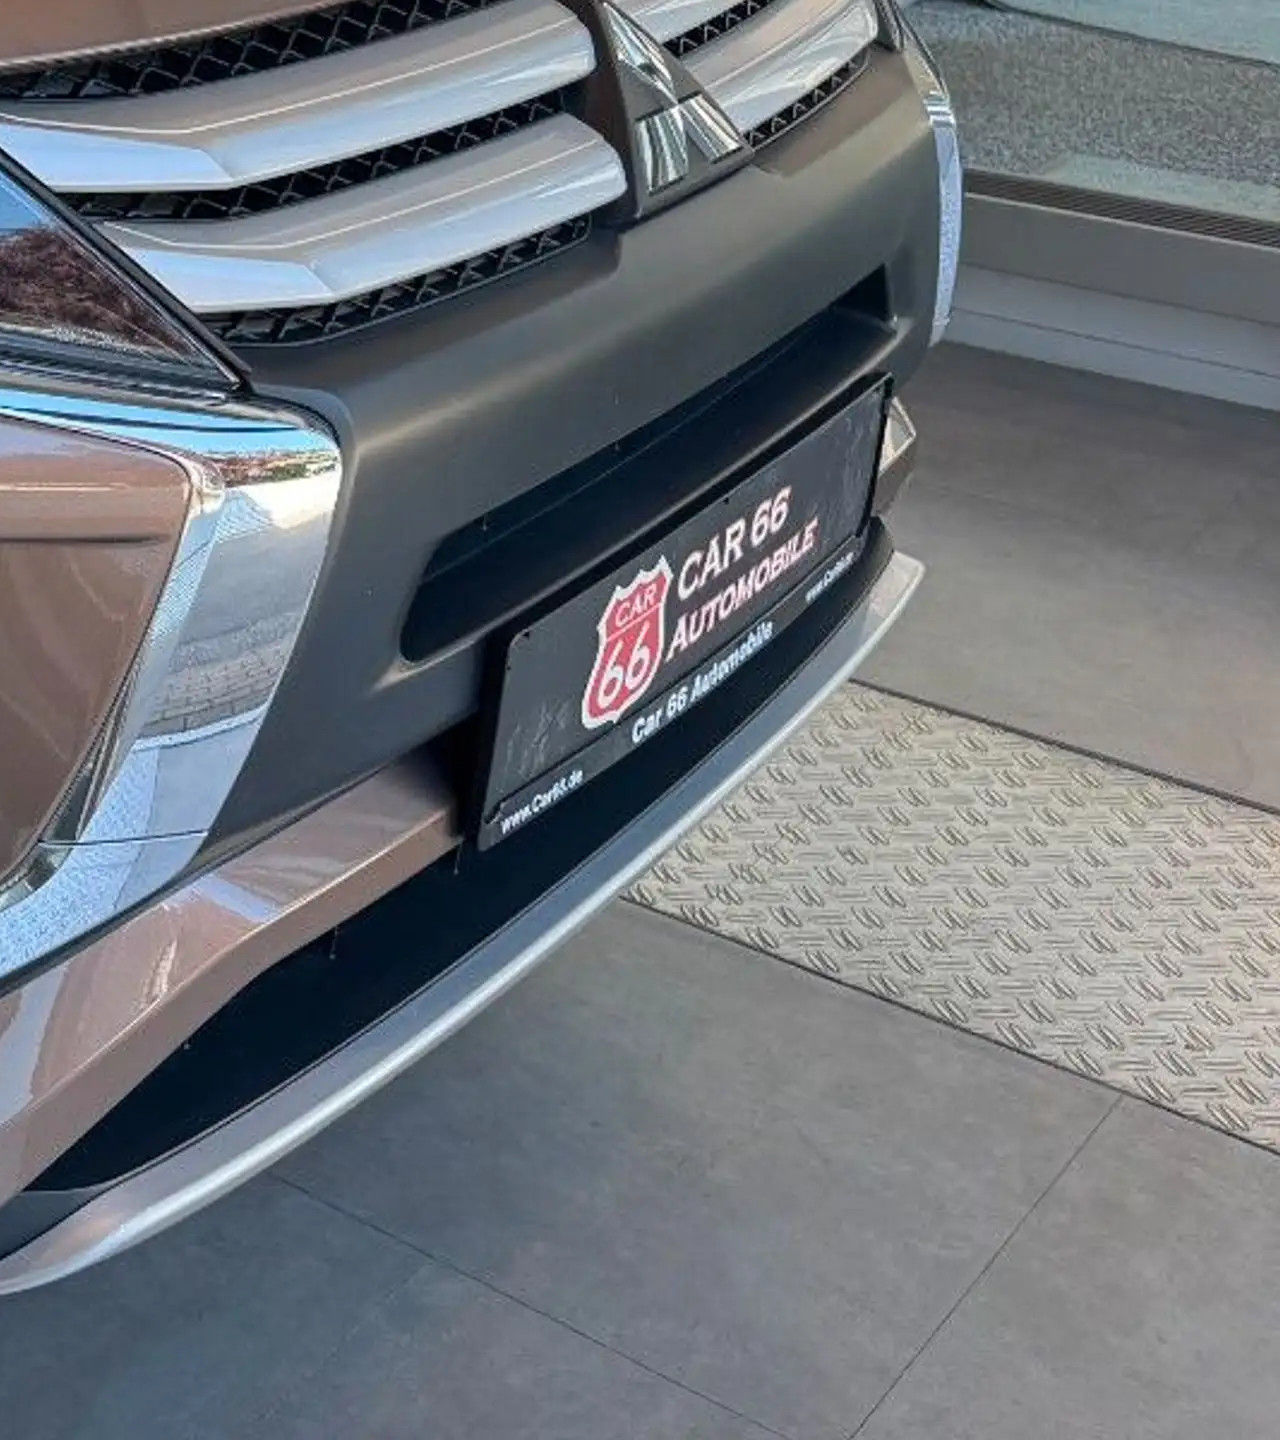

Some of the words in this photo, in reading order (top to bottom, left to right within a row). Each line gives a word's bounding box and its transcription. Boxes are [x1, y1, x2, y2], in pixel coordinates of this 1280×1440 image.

[678, 517, 746, 600] CAR
[751, 485, 792, 547] 66
[615, 583, 657, 628] CAR
[666, 516, 819, 662] AUTOMOBILE
[598, 620, 651, 709] 66
[632, 708, 663, 743] Car
[667, 685, 689, 718] 66
